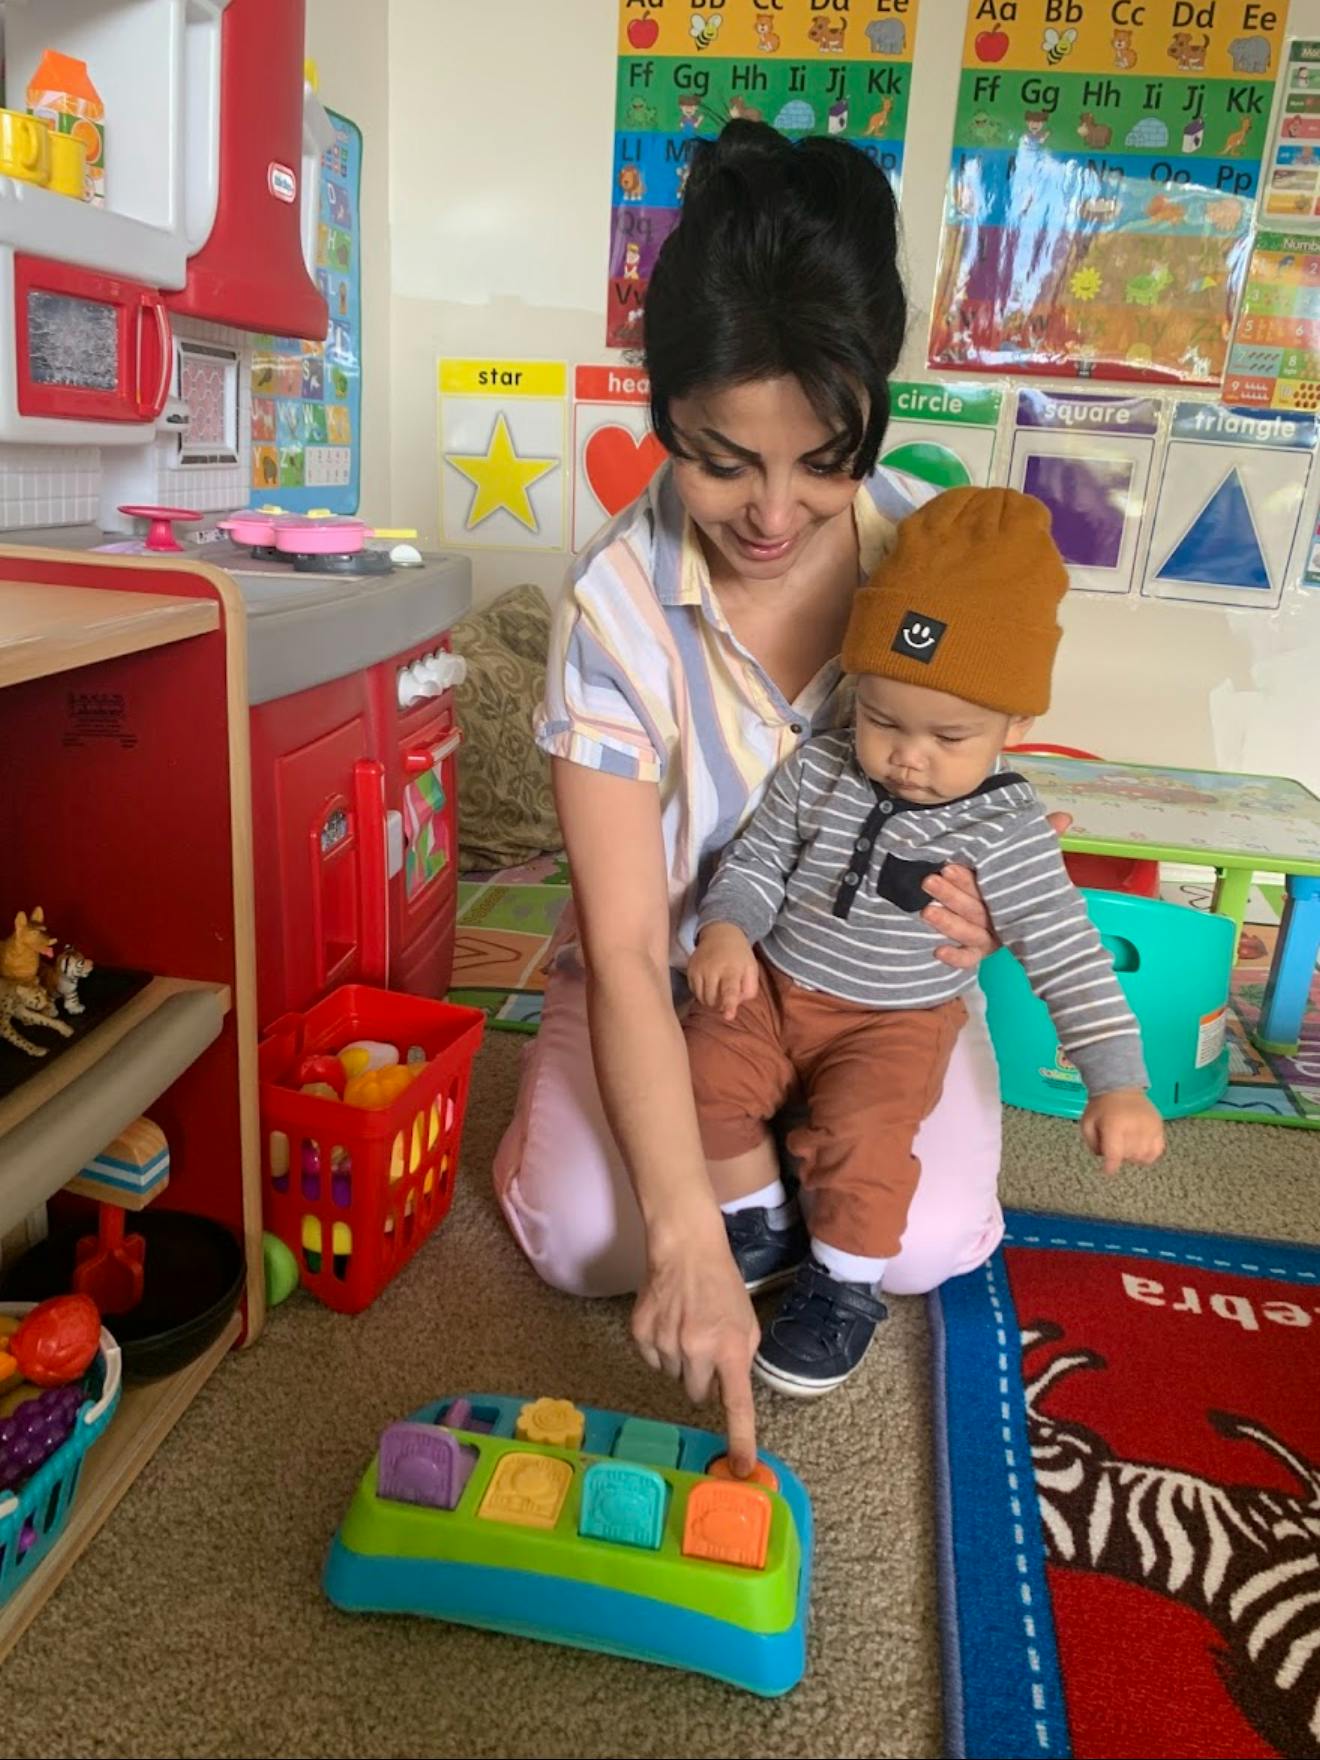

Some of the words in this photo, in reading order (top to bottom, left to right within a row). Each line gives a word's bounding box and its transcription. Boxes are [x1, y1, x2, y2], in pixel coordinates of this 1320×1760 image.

[975, 0, 1018, 21] Aa
[1045, 0, 1083, 23] Bb
[1111, 0, 1146, 26] Cc
[1172, 1, 1216, 29] Dd
[1243, 4, 1277, 31] Ee
[629, 61, 655, 88] Ff
[673, 63, 710, 97] Gg
[731, 64, 768, 90] Hh
[788, 65, 807, 92] Ii
[826, 66, 846, 101] Jj
[867, 67, 903, 95] Kk
[973, 76, 1001, 102] Ff
[1021, 78, 1060, 113] Gg
[1082, 80, 1121, 107] Hh
[1142, 83, 1164, 110] Ii
[1182, 84, 1206, 119] Jj
[1226, 86, 1264, 114] Kk
[1216, 165, 1252, 194] Pp
[478, 368, 523, 386] star
[608, 372, 651, 394] hea
[897, 389, 963, 414] circle
[1043, 401, 1131, 425] square
[1194, 410, 1297, 439] triangle
[1121, 1272, 1320, 1331] ebra
